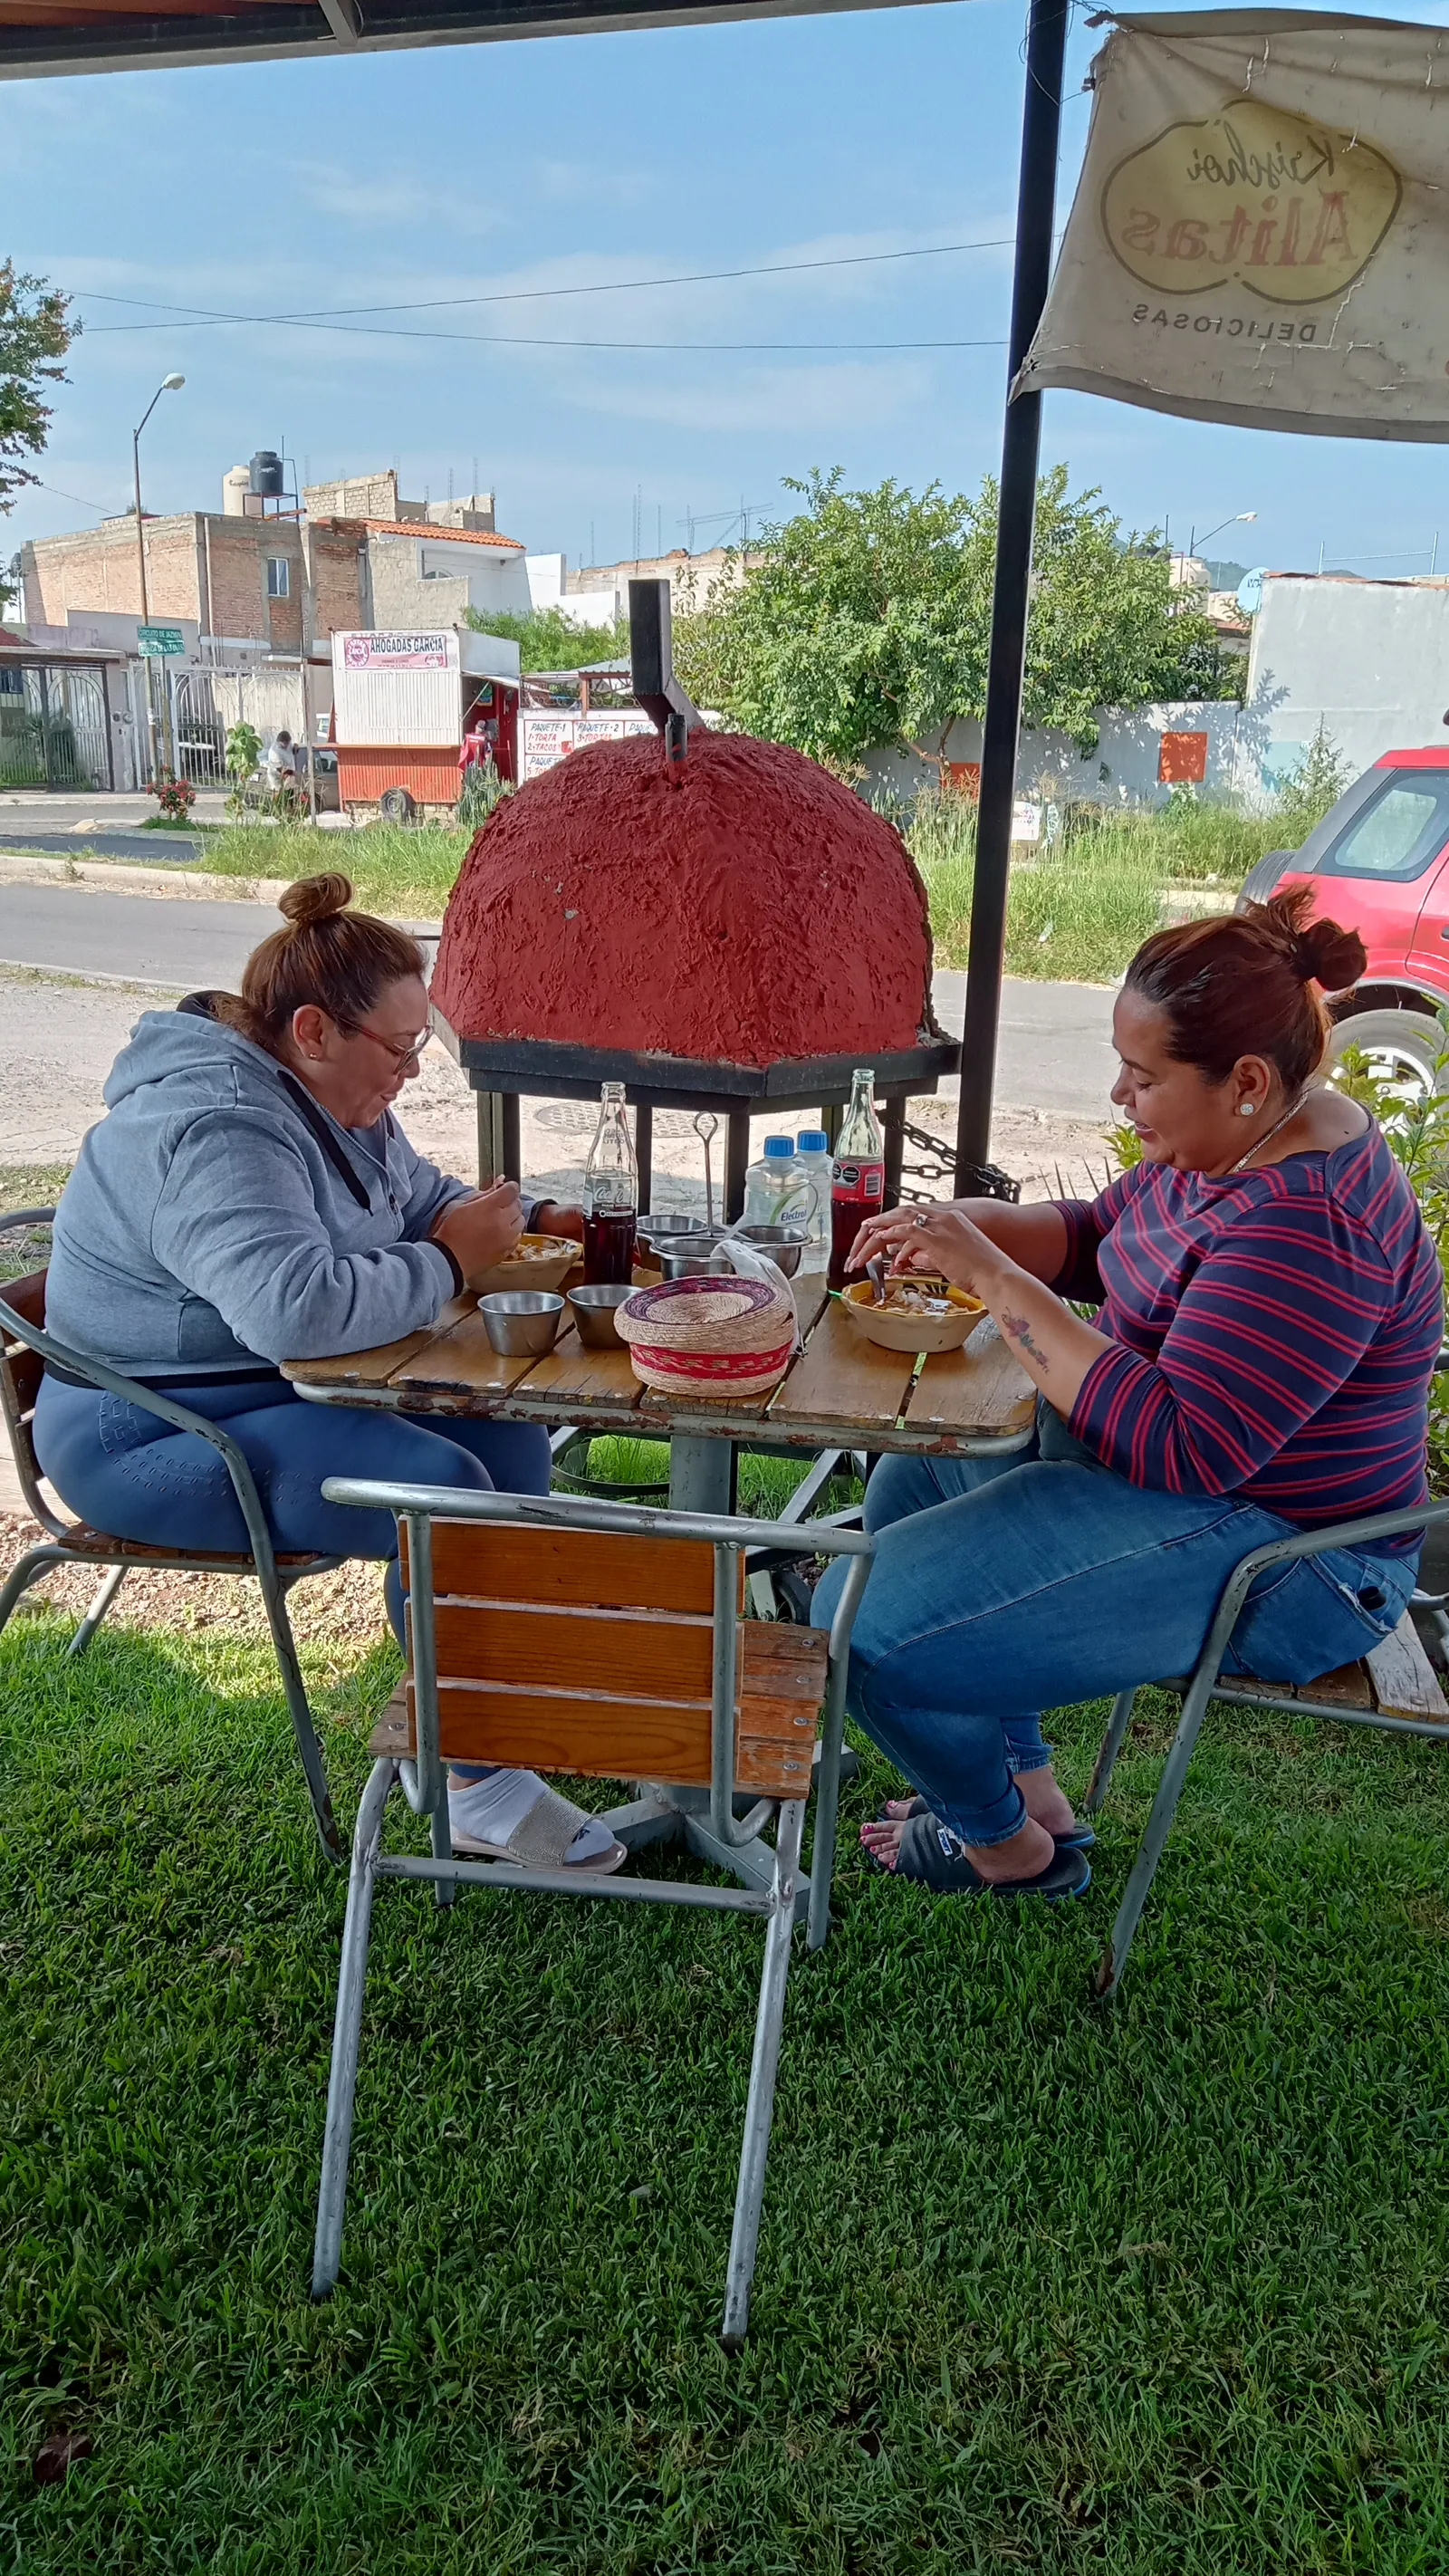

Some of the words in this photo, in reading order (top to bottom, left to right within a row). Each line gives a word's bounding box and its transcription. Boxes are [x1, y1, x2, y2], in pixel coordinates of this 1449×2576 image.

[158, 630, 166, 638] DE
[370, 638, 412, 653] AHOGADAS
[414, 637, 444, 652] GARCIA
